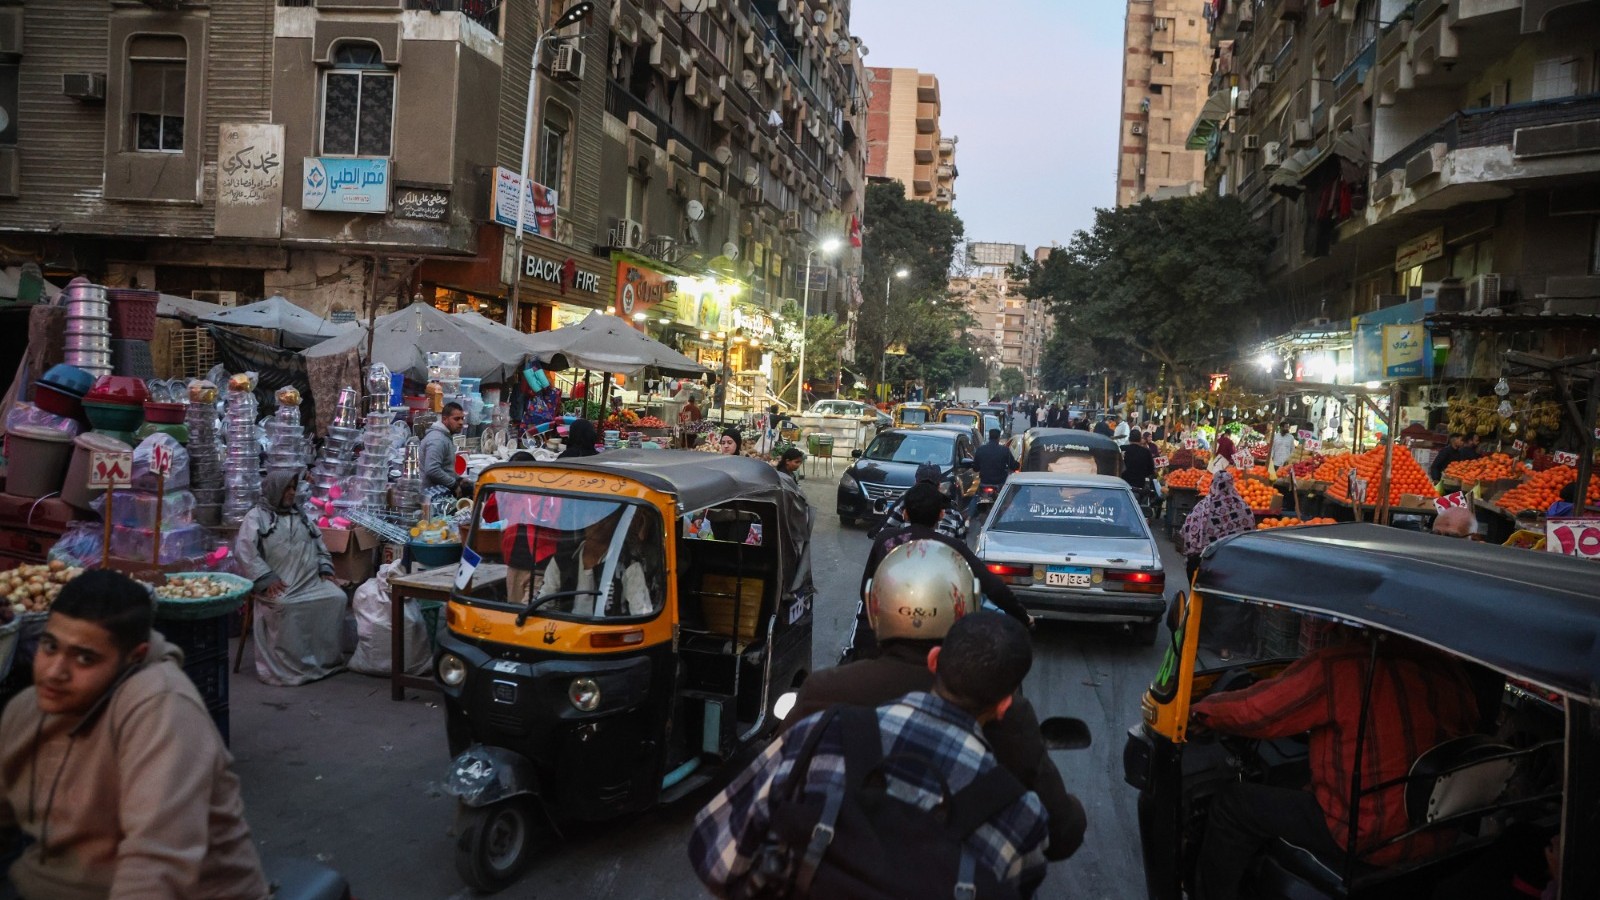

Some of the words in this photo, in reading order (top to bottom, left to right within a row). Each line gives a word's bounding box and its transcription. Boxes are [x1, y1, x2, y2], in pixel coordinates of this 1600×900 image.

[361, 171, 384, 188] مصر
[525, 254, 562, 284] BACK
[575, 269, 601, 294] FIRE
[96, 460, 125, 480] ١٨
[1029, 503, 1040, 513] الله
[1041, 503, 1058, 515] رسول
[1058, 504, 1075, 513] محمد
[1076, 503, 1088, 513] الله
[1049, 573, 1065, 583] ٤٦٧
[898, 606, 937, 617] G&J
